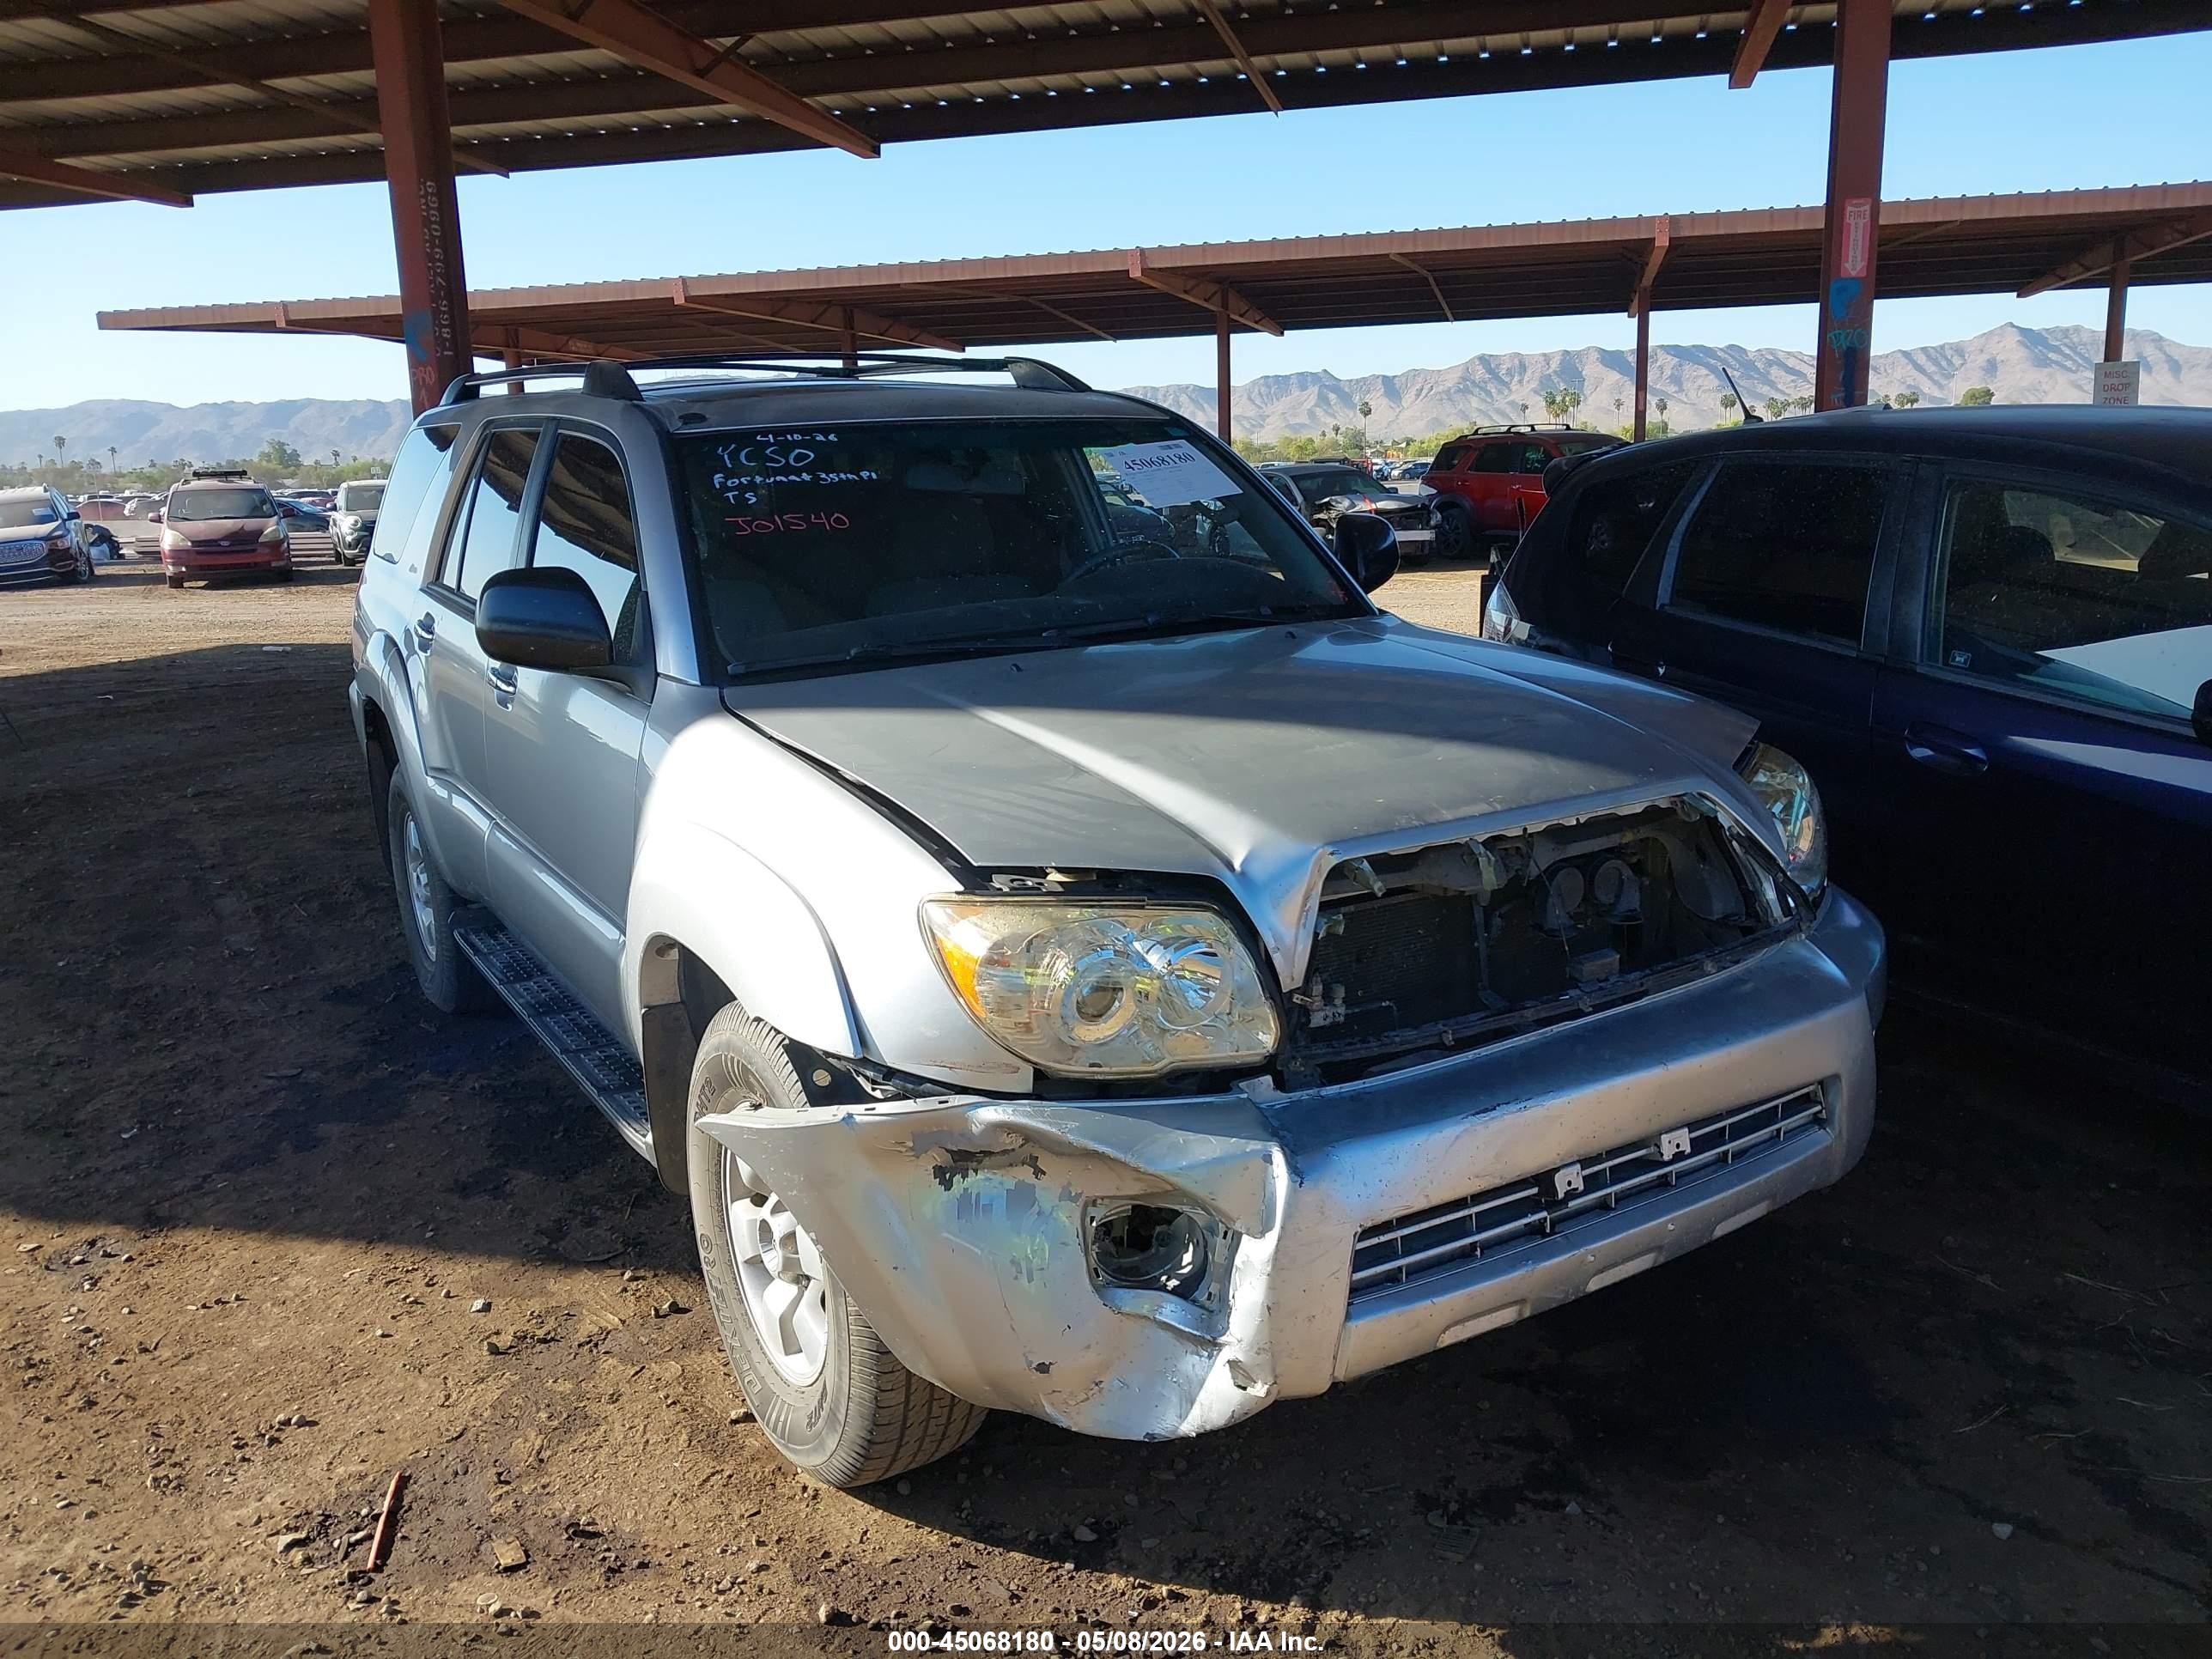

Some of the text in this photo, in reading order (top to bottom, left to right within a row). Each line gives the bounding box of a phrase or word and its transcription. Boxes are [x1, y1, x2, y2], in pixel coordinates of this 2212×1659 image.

[1848, 210, 1869, 221] FIRE
[2104, 370, 2130, 379] MISC
[2102, 383, 2130, 392] DROP
[2102, 397, 2130, 405] ZONE
[756, 433, 839, 443] 4-10-26
[716, 443, 815, 468] YCSO
[1122, 451, 1196, 471] 45068180
[699, 1232, 763, 1395] DEXTERO
